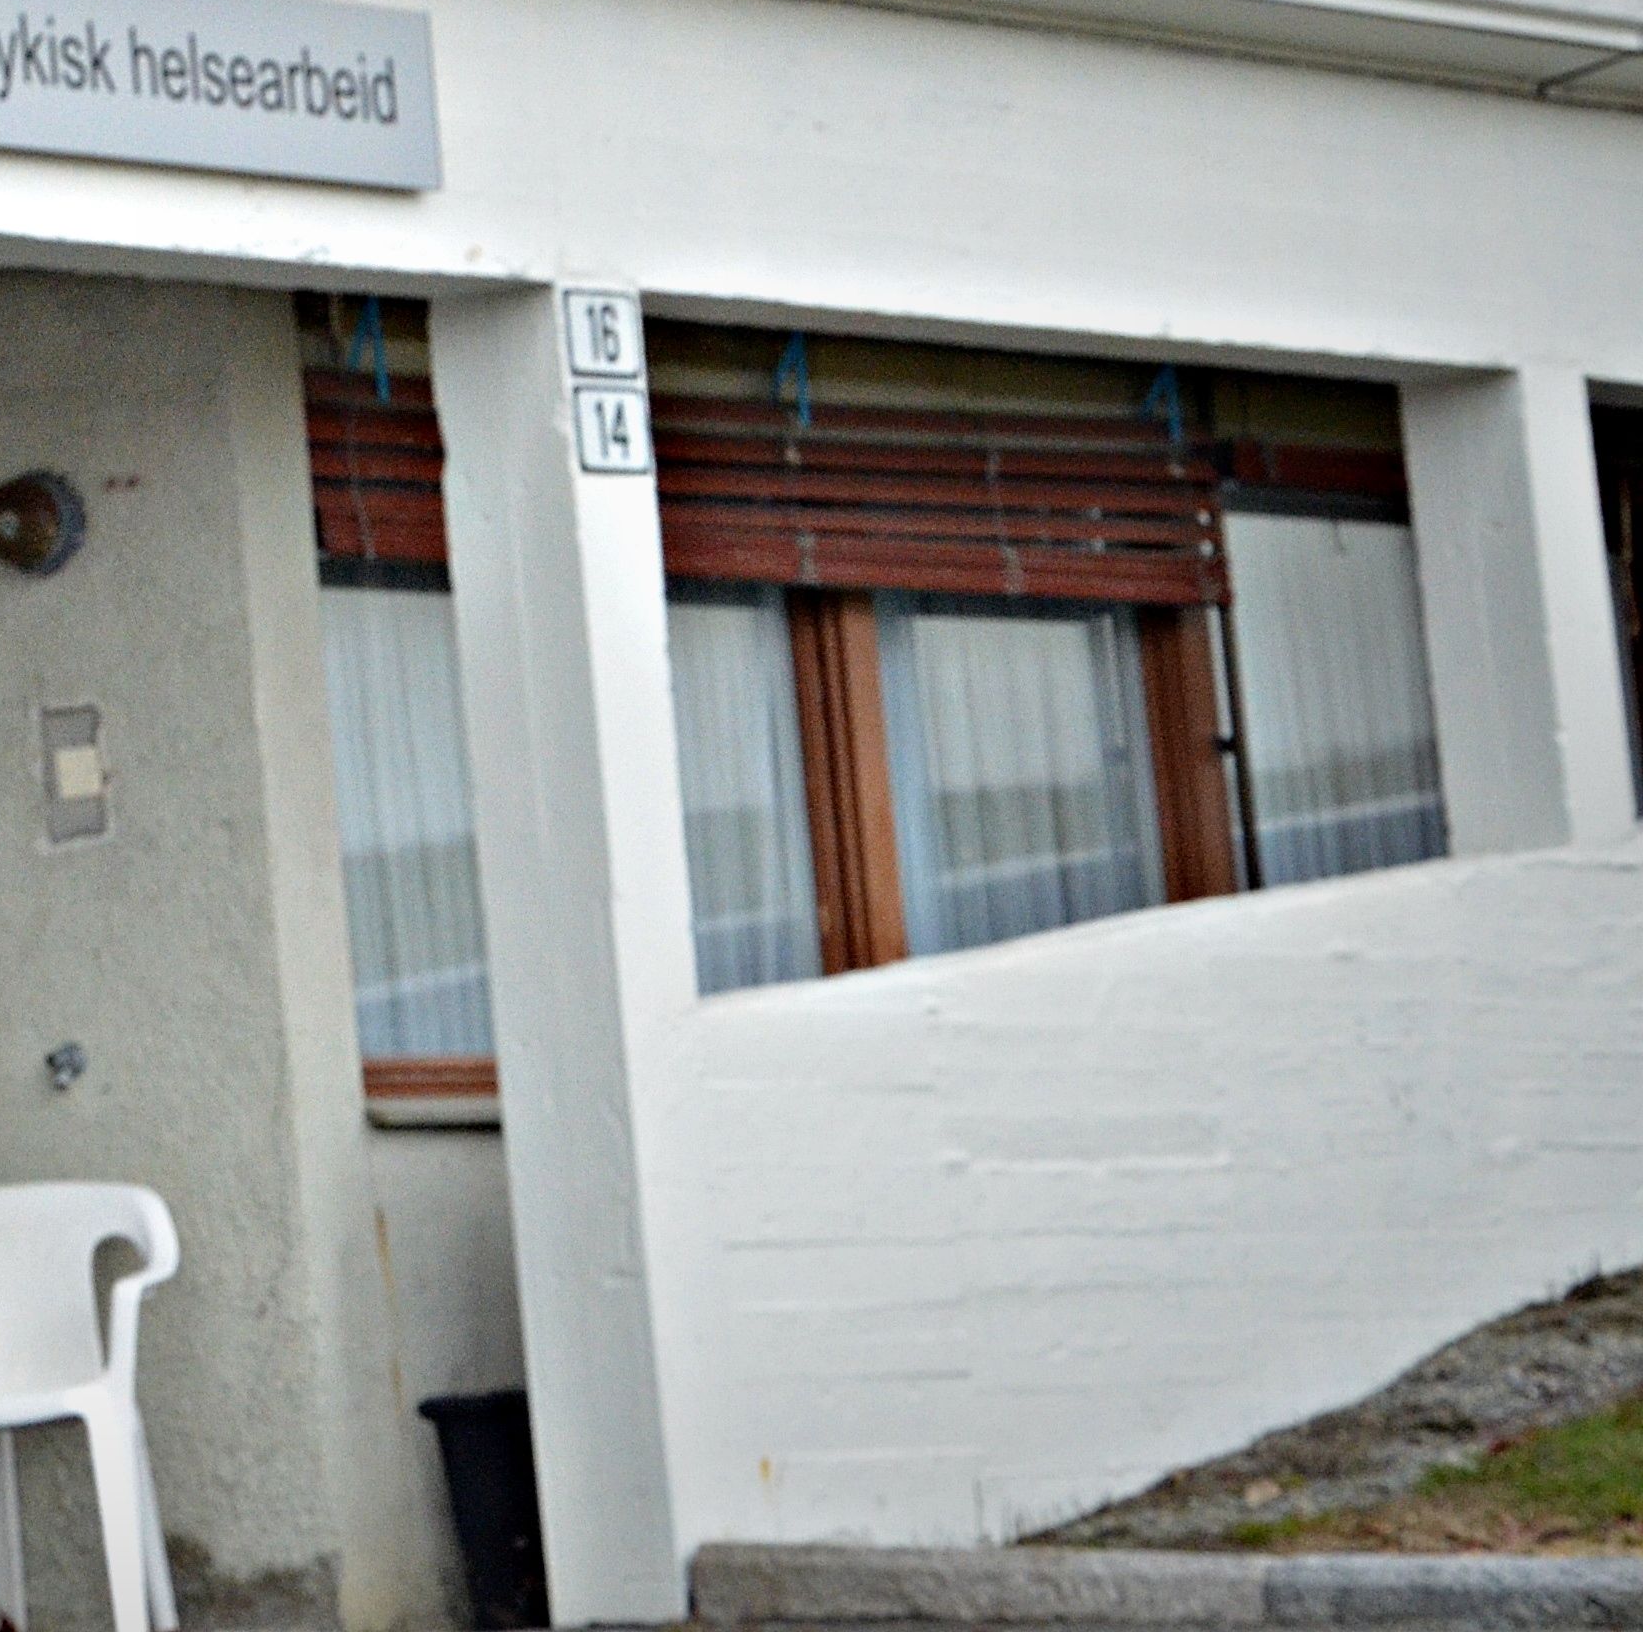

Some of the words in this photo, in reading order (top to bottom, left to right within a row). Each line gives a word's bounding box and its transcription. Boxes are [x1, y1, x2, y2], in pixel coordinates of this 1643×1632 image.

[126, 23, 400, 126] helsearbeid
[586, 302, 621, 363] 16
[594, 399, 631, 461] 14
